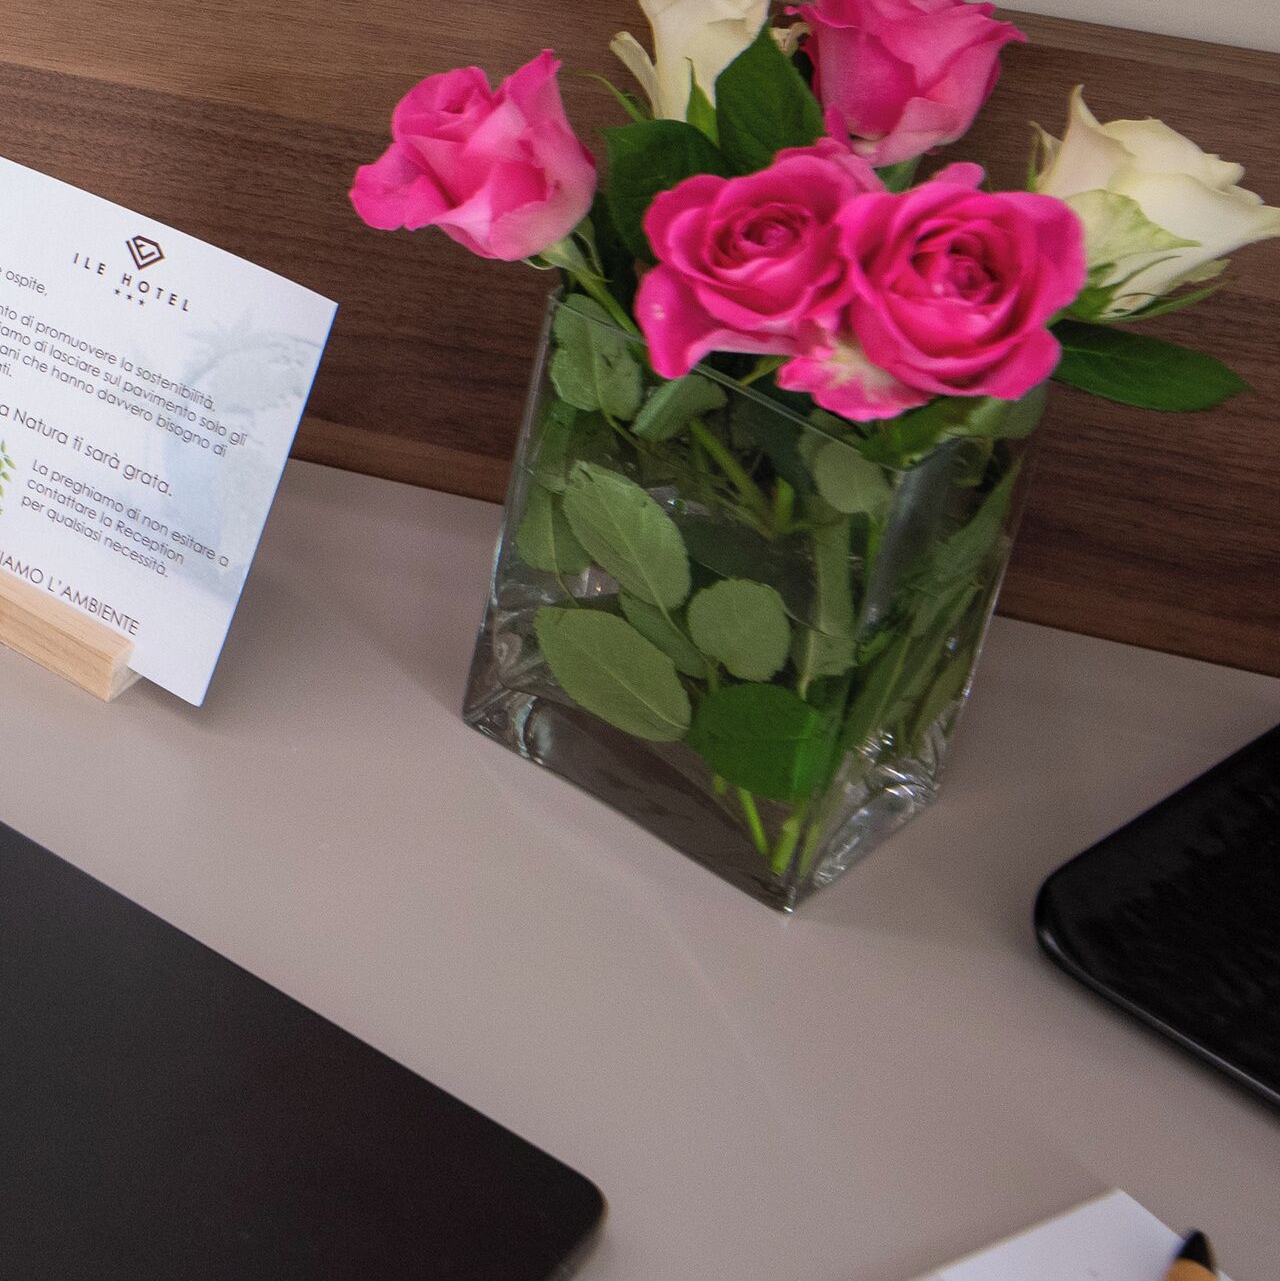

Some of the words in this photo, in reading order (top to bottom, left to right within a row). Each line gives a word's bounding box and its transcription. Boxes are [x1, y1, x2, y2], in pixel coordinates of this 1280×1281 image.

[5, 270, 48, 296] ospite,
[72, 253, 107, 275] ILE
[121, 273, 190, 312] HOTEL
[20, 314, 35, 328] di
[34, 321, 123, 365] promuovere
[120, 357, 134, 372] la
[135, 365, 216, 413] sostenibilità.
[22, 353, 48, 373] che
[51, 365, 95, 394] hanno
[97, 386, 153, 423] davvero
[156, 413, 210, 450] bisogno
[212, 440, 229, 458] di
[34, 340, 48, 353] di
[48, 344, 101, 377] lasciare
[103, 370, 122, 388] sul
[123, 379, 197, 422] pavimento
[199, 417, 227, 437] solo
[229, 429, 248, 447] gli
[14, 408, 70, 446] Natura
[72, 433, 86, 452] ti
[84, 441, 121, 471] sarà
[123, 462, 175, 497] grata.
[20, 493, 46, 513] per
[47, 506, 103, 542] qualsiasi
[103, 536, 169, 578] necessità.
[26, 478, 105, 520] contattare
[99, 511, 114, 528] la
[115, 519, 186, 566] Reception
[32, 459, 49, 475] La
[49, 467, 125, 514] preghiamo
[126, 505, 142, 521] di
[142, 515, 170, 536] non
[171, 527, 217, 560] esitare
[218, 554, 230, 568] a
